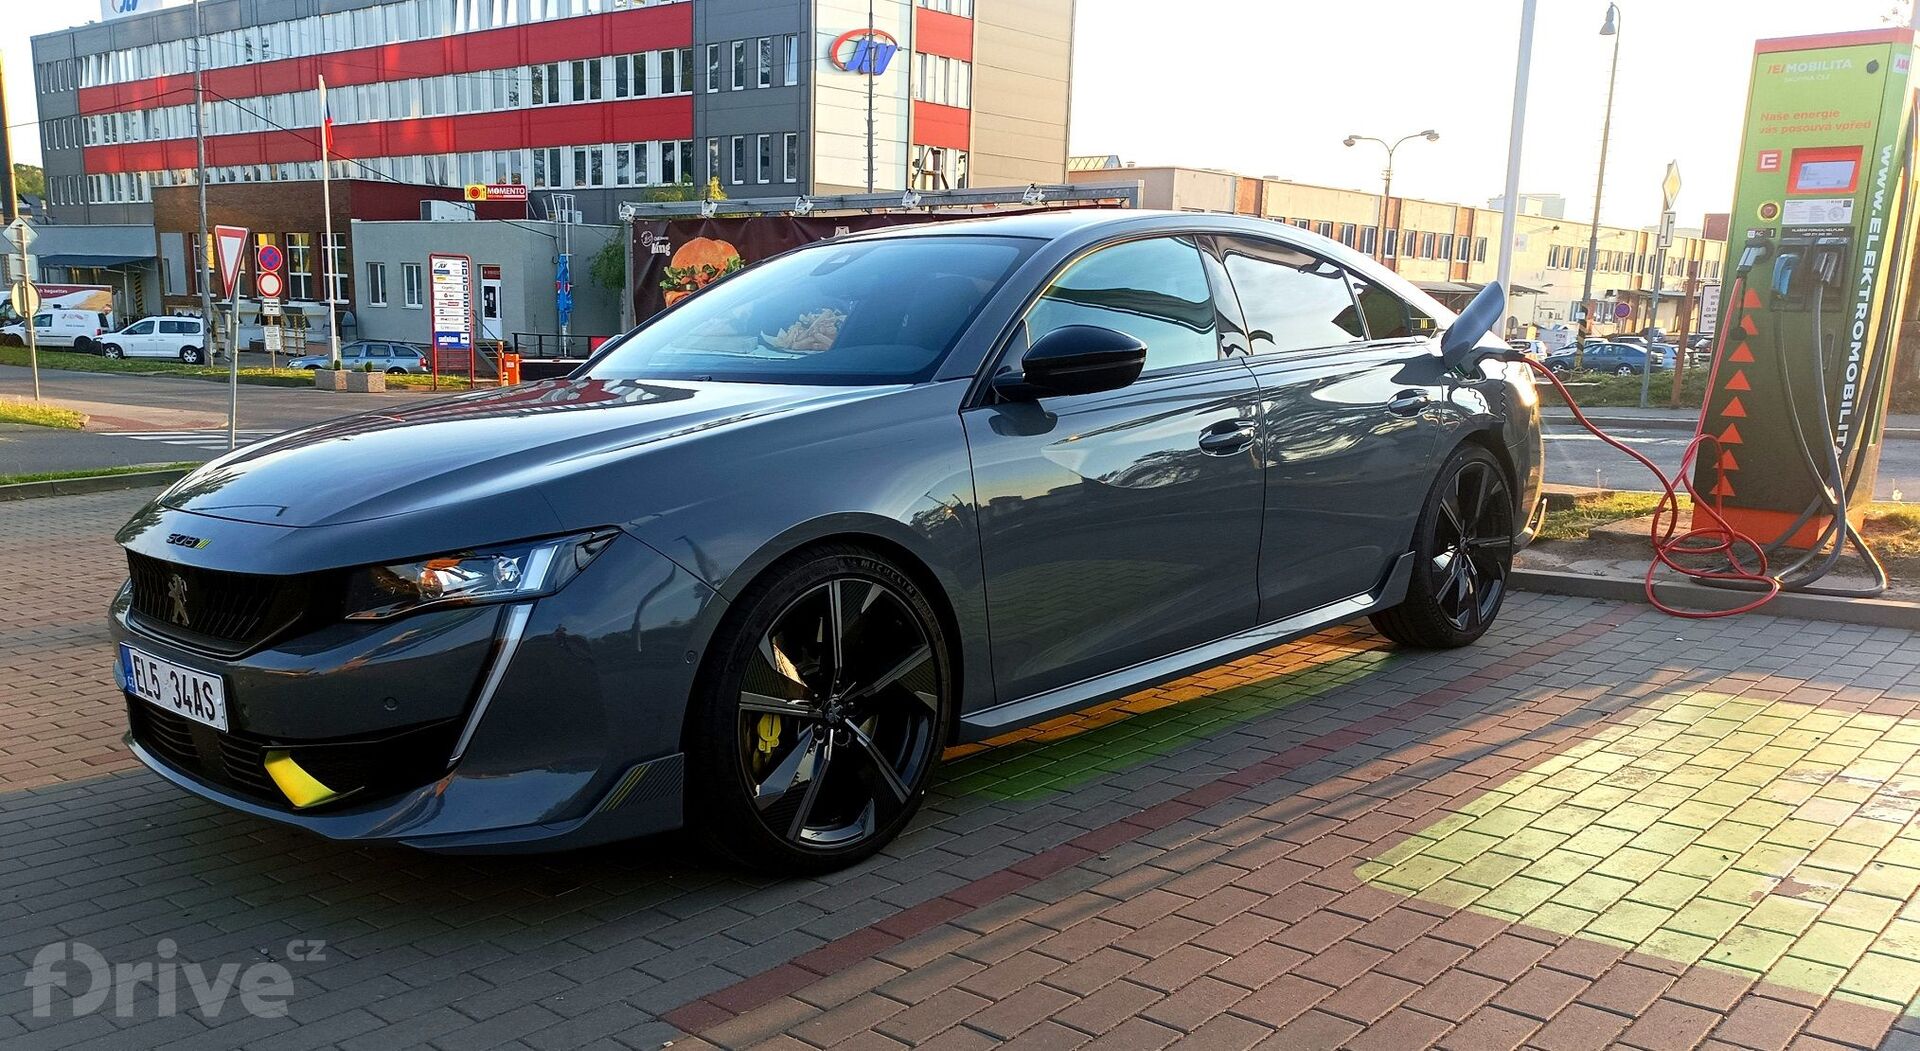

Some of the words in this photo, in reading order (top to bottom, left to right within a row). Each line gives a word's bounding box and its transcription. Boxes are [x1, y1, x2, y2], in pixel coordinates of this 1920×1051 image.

[1793, 110, 1840, 120] energie
[487, 187, 526, 195] MOMENTO
[166, 533, 200, 548] 508
[860, 559, 915, 595] MICHELIN
[133, 655, 161, 700] EL5
[169, 670, 216, 721] 34AS
